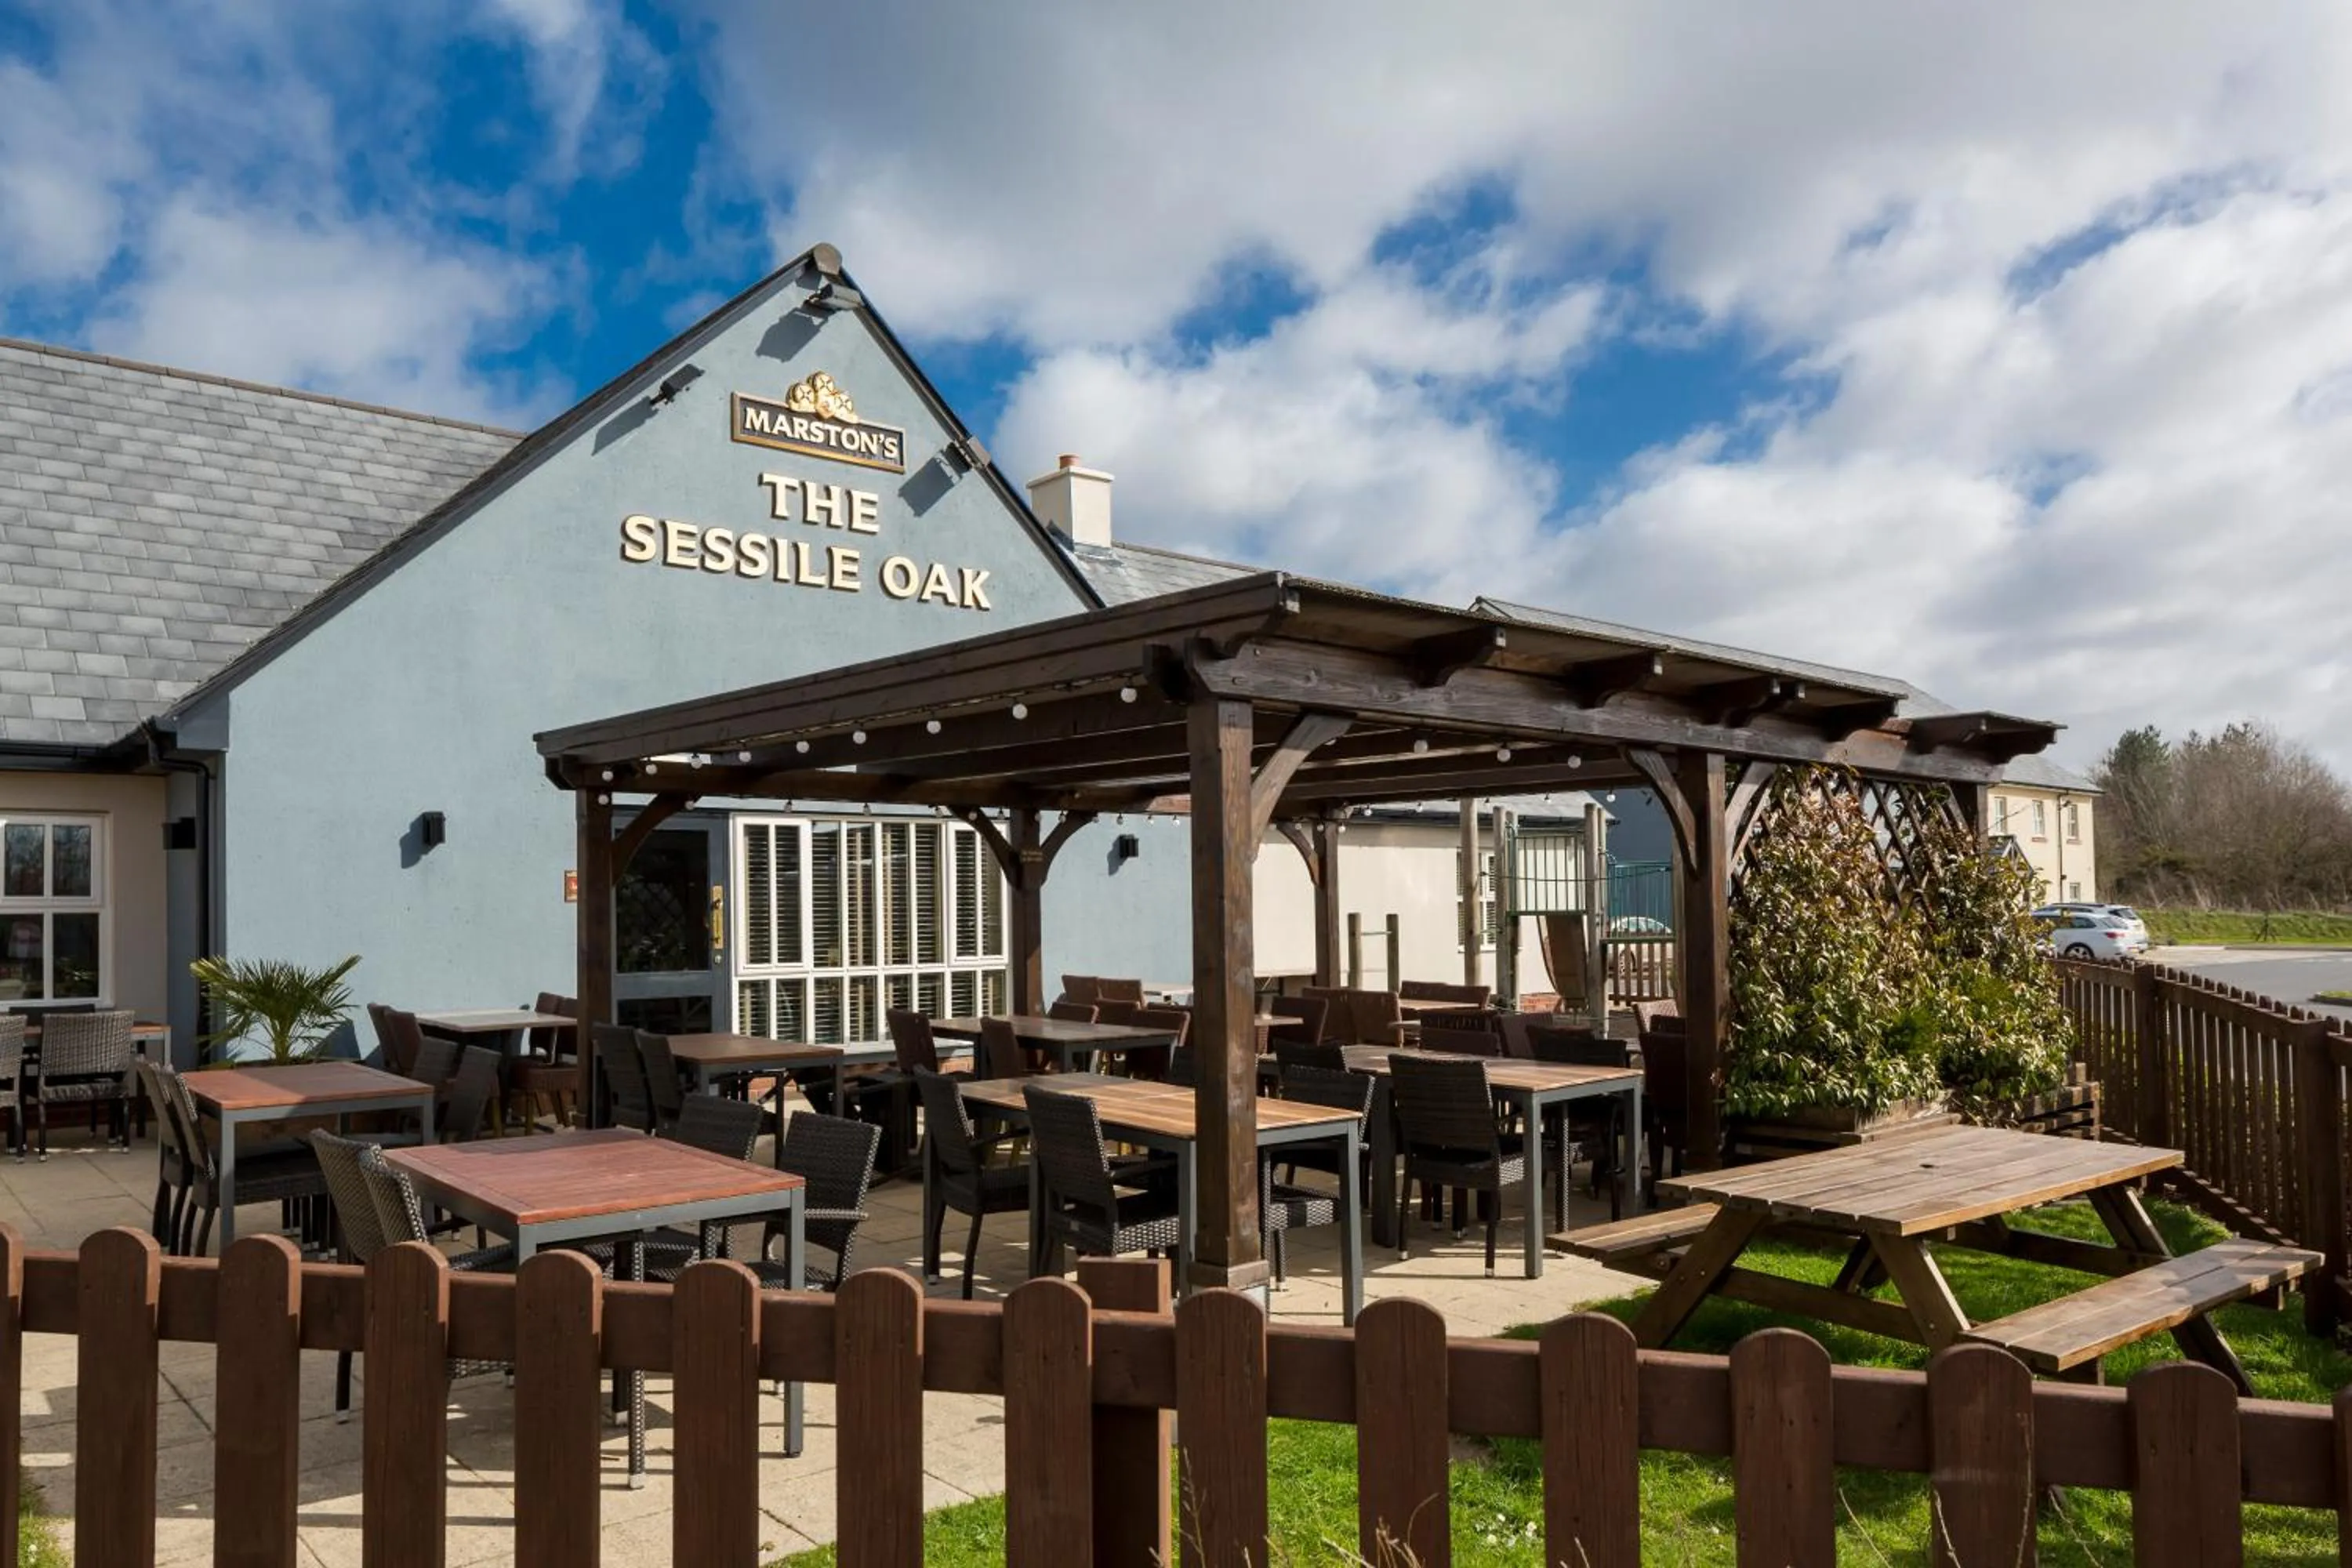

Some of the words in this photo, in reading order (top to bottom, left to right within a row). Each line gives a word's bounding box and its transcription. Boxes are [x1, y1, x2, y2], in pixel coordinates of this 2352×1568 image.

[746, 407, 899, 459] MARSTON'S
[760, 472, 880, 534] THE
[621, 514, 861, 592] SESSILE
[880, 556, 991, 611] OAK
